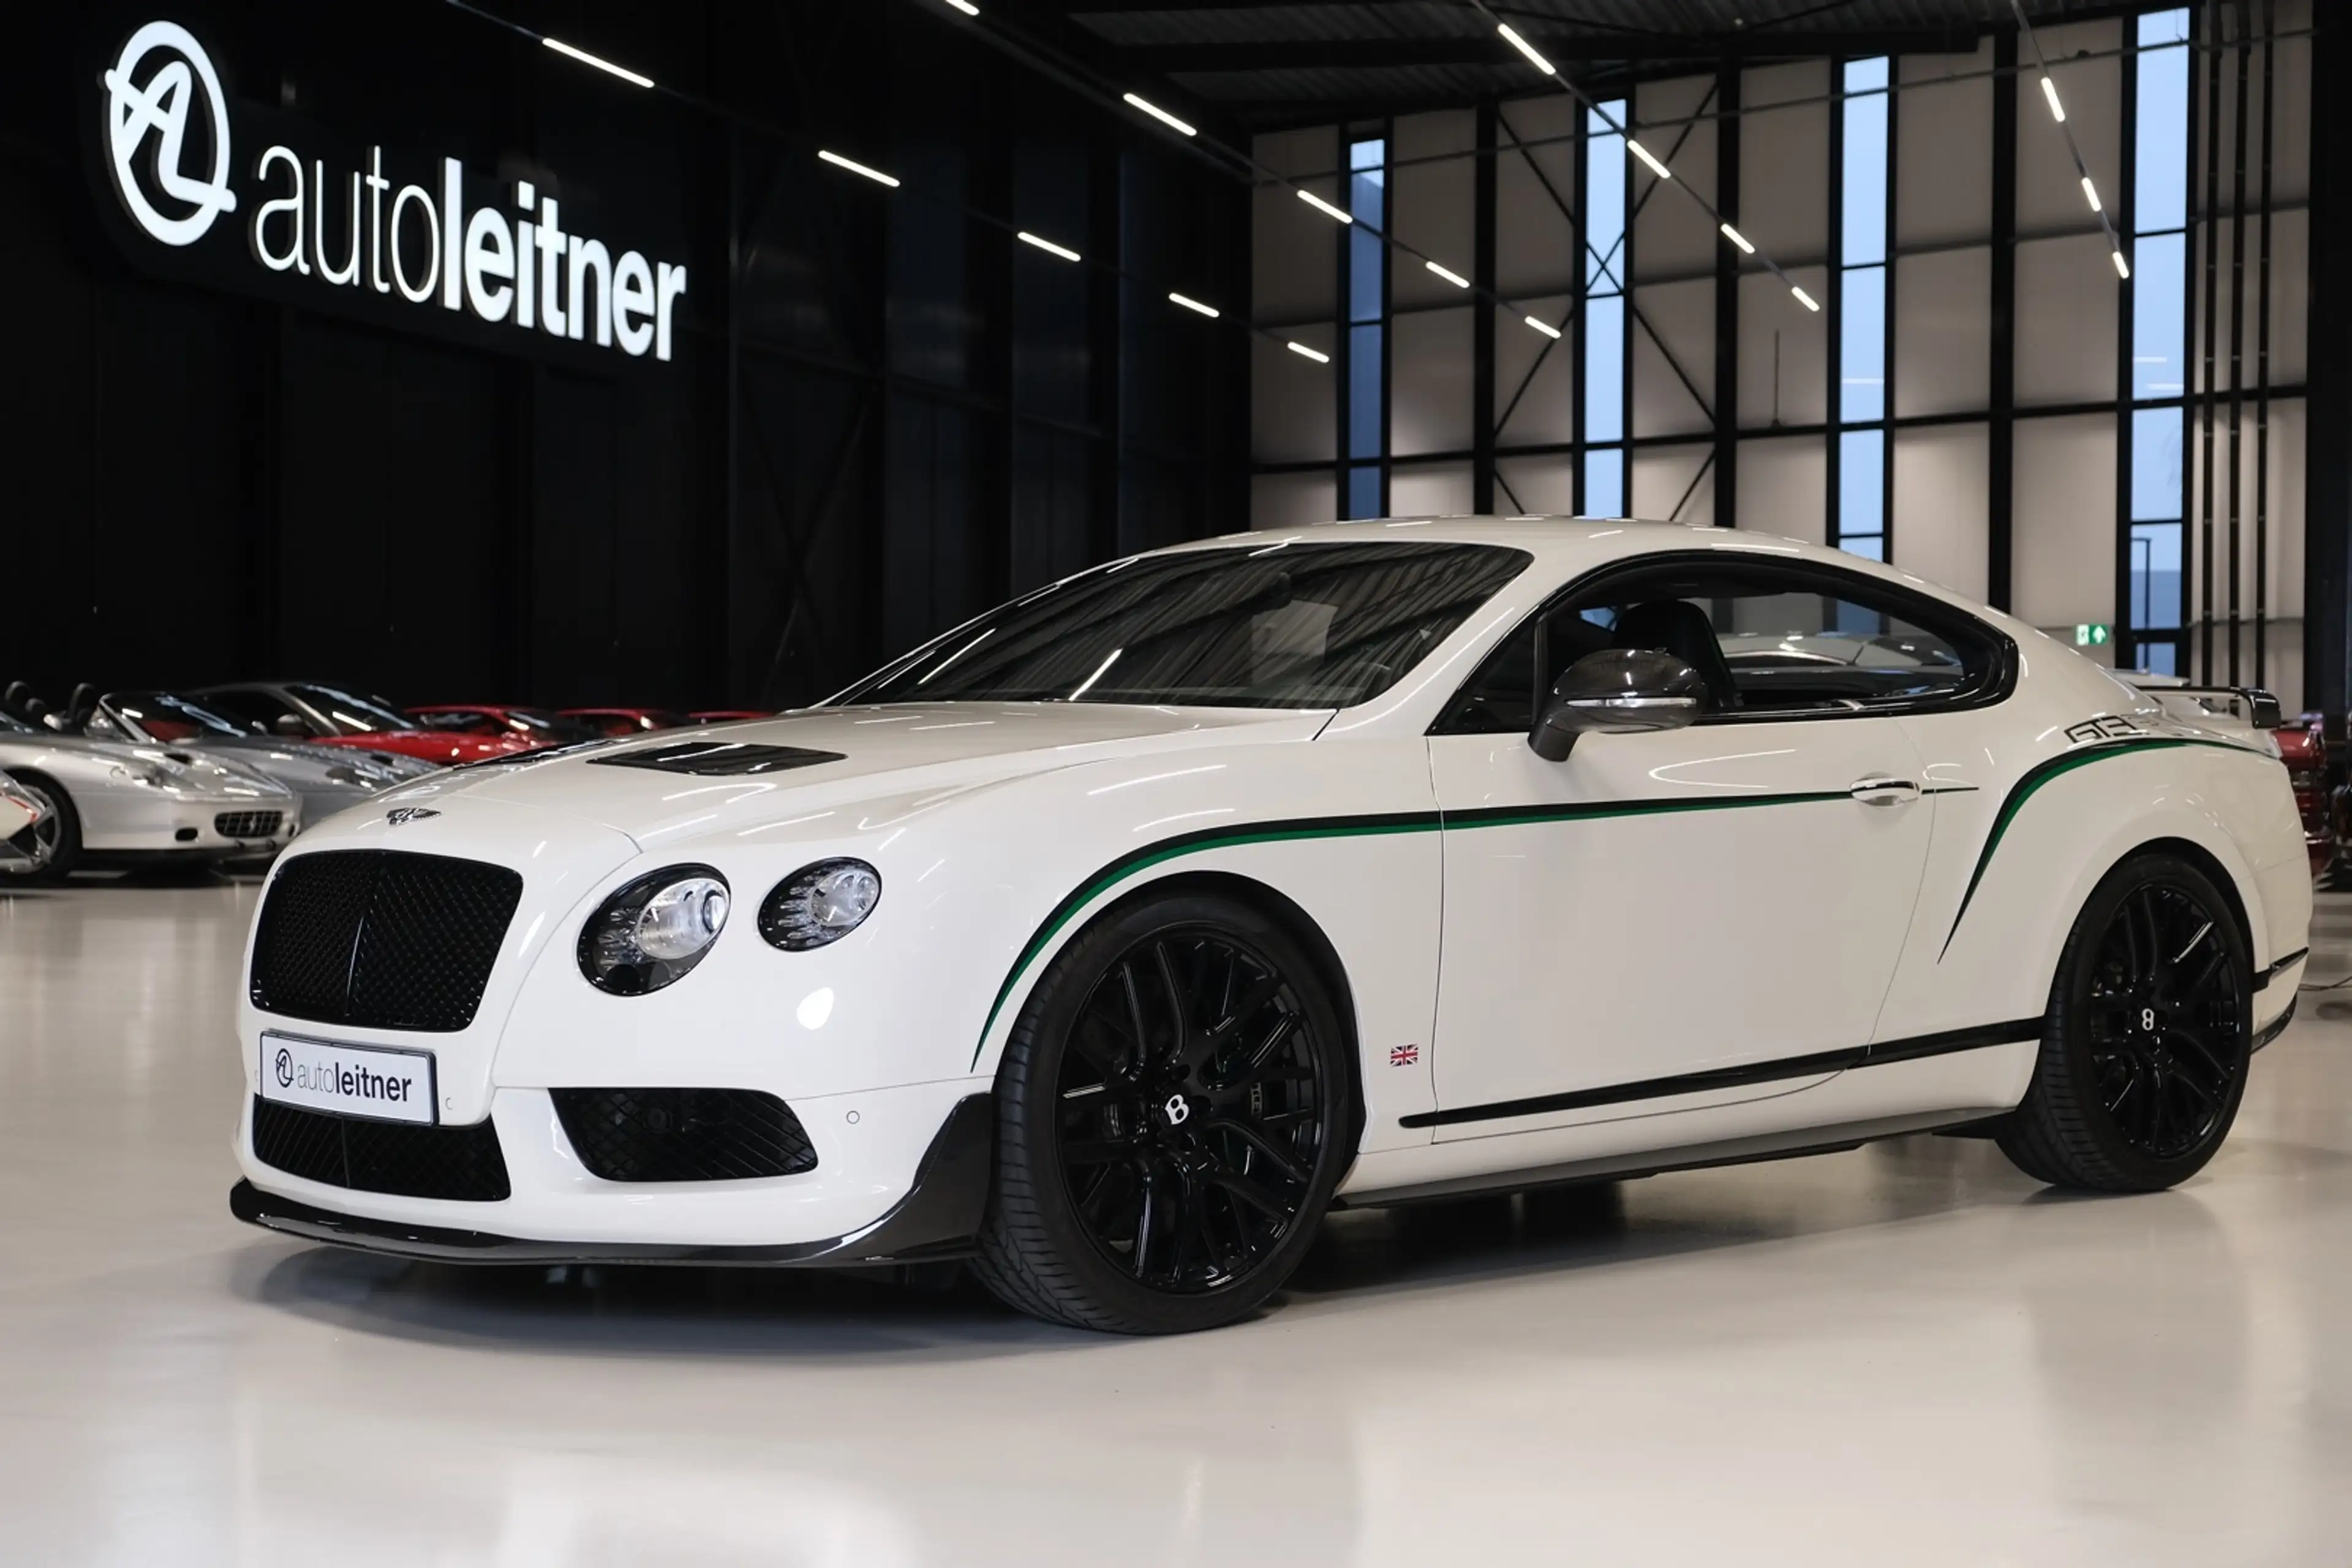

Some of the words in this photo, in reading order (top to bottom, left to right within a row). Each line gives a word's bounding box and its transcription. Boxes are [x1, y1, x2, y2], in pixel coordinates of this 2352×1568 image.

[256, 146, 686, 361] autoleitner
[298, 1062, 412, 1102] autoleitner
[1165, 1095, 1188, 1124] B
